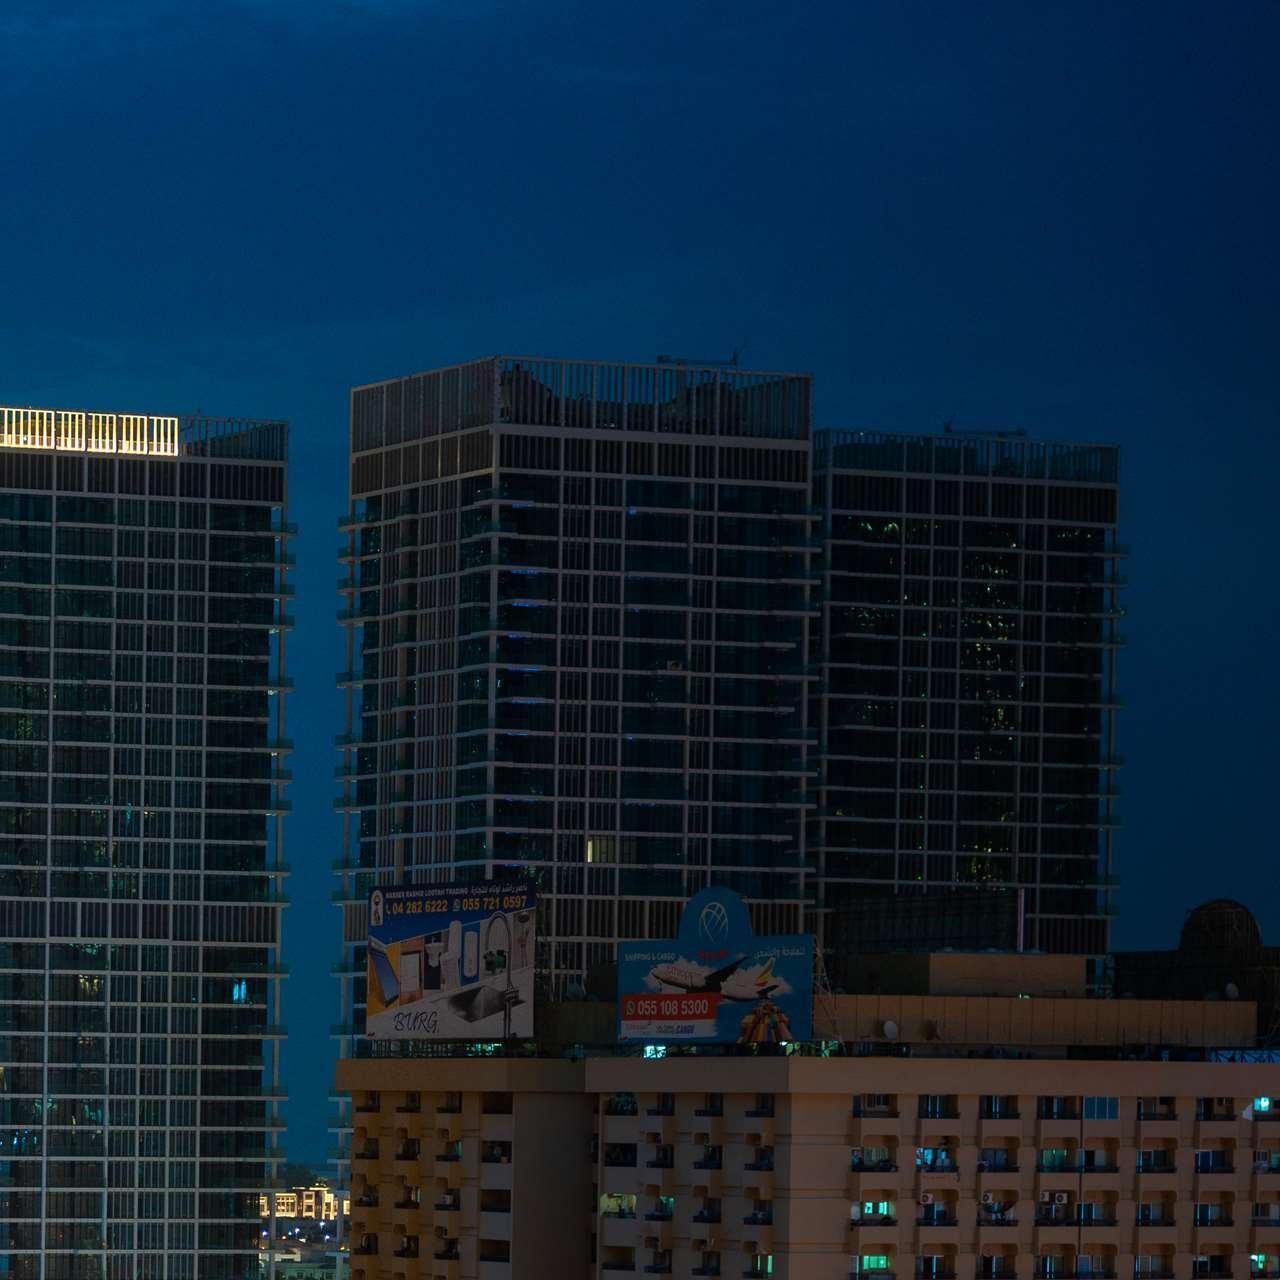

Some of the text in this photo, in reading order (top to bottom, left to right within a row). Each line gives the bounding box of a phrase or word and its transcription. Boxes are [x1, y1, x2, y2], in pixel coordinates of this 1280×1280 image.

[392, 899, 448, 914] 04 282 6222
[462, 895, 528, 911] 055 721 0597
[638, 999, 708, 1015] 055 108 5300
